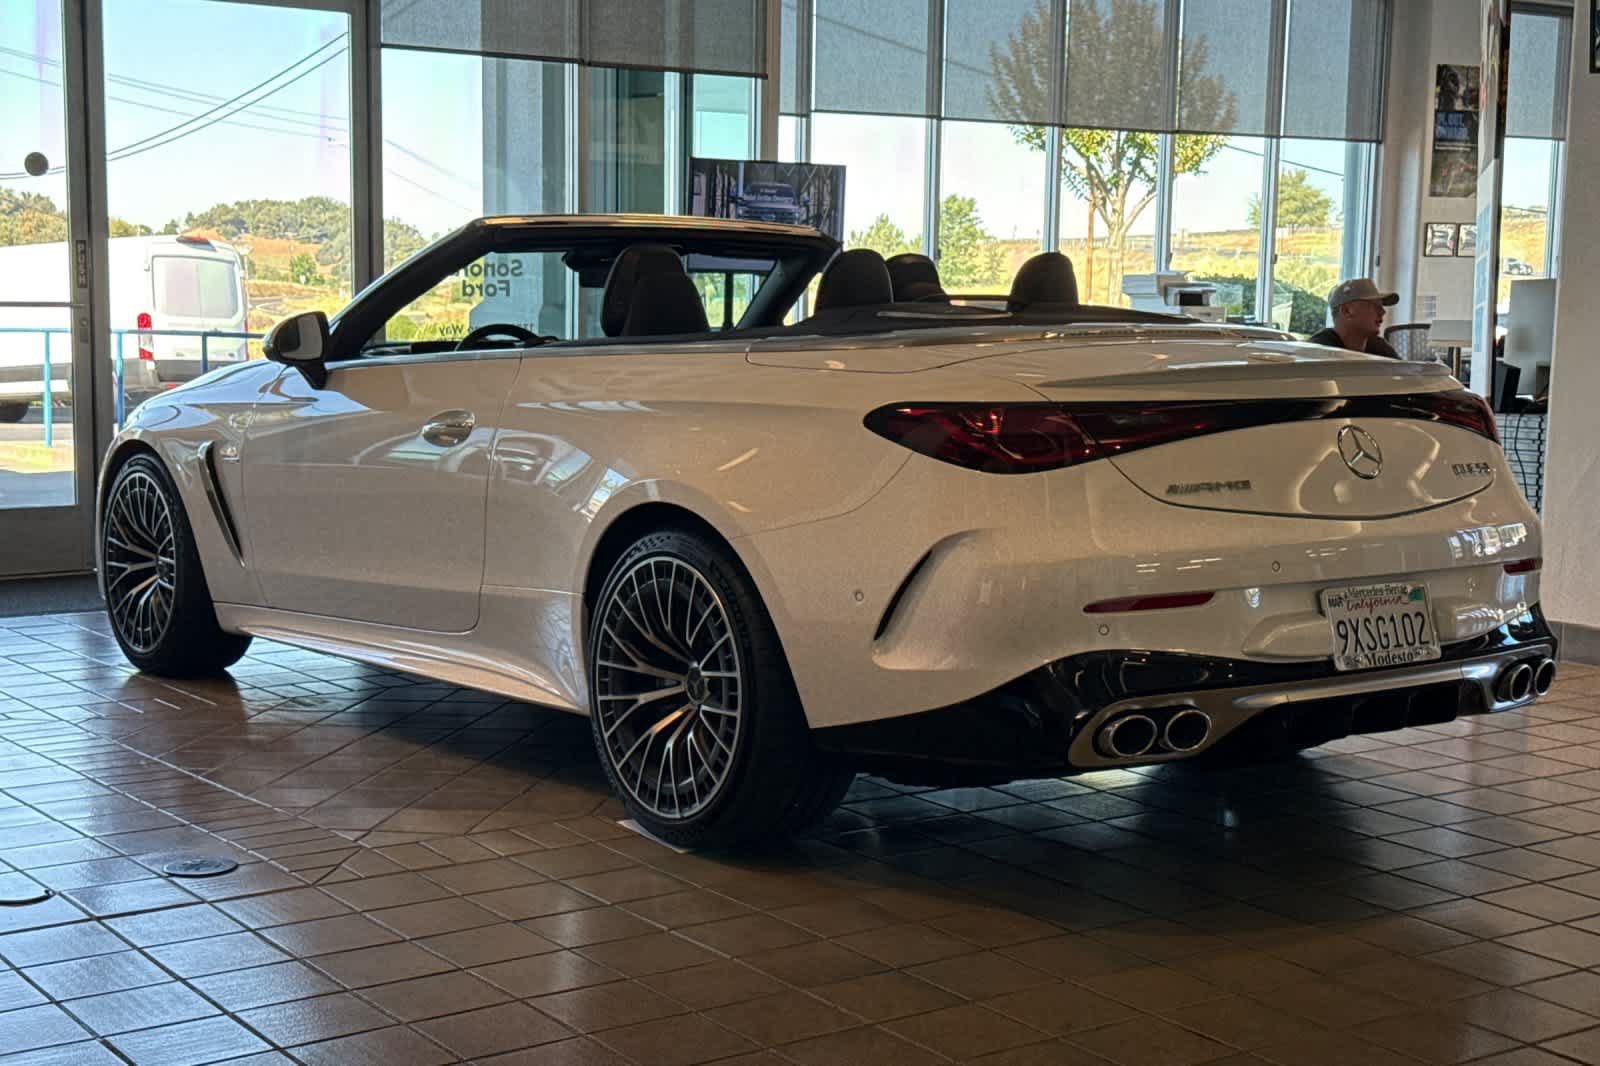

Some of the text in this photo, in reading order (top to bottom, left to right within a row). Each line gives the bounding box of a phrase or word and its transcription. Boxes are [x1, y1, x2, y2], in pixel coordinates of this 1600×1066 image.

[77, 243, 85, 284] PUSH
[1346, 597, 1409, 613] California
[1336, 611, 1430, 654] 9XSG102
[1365, 650, 1414, 666] Modesto
